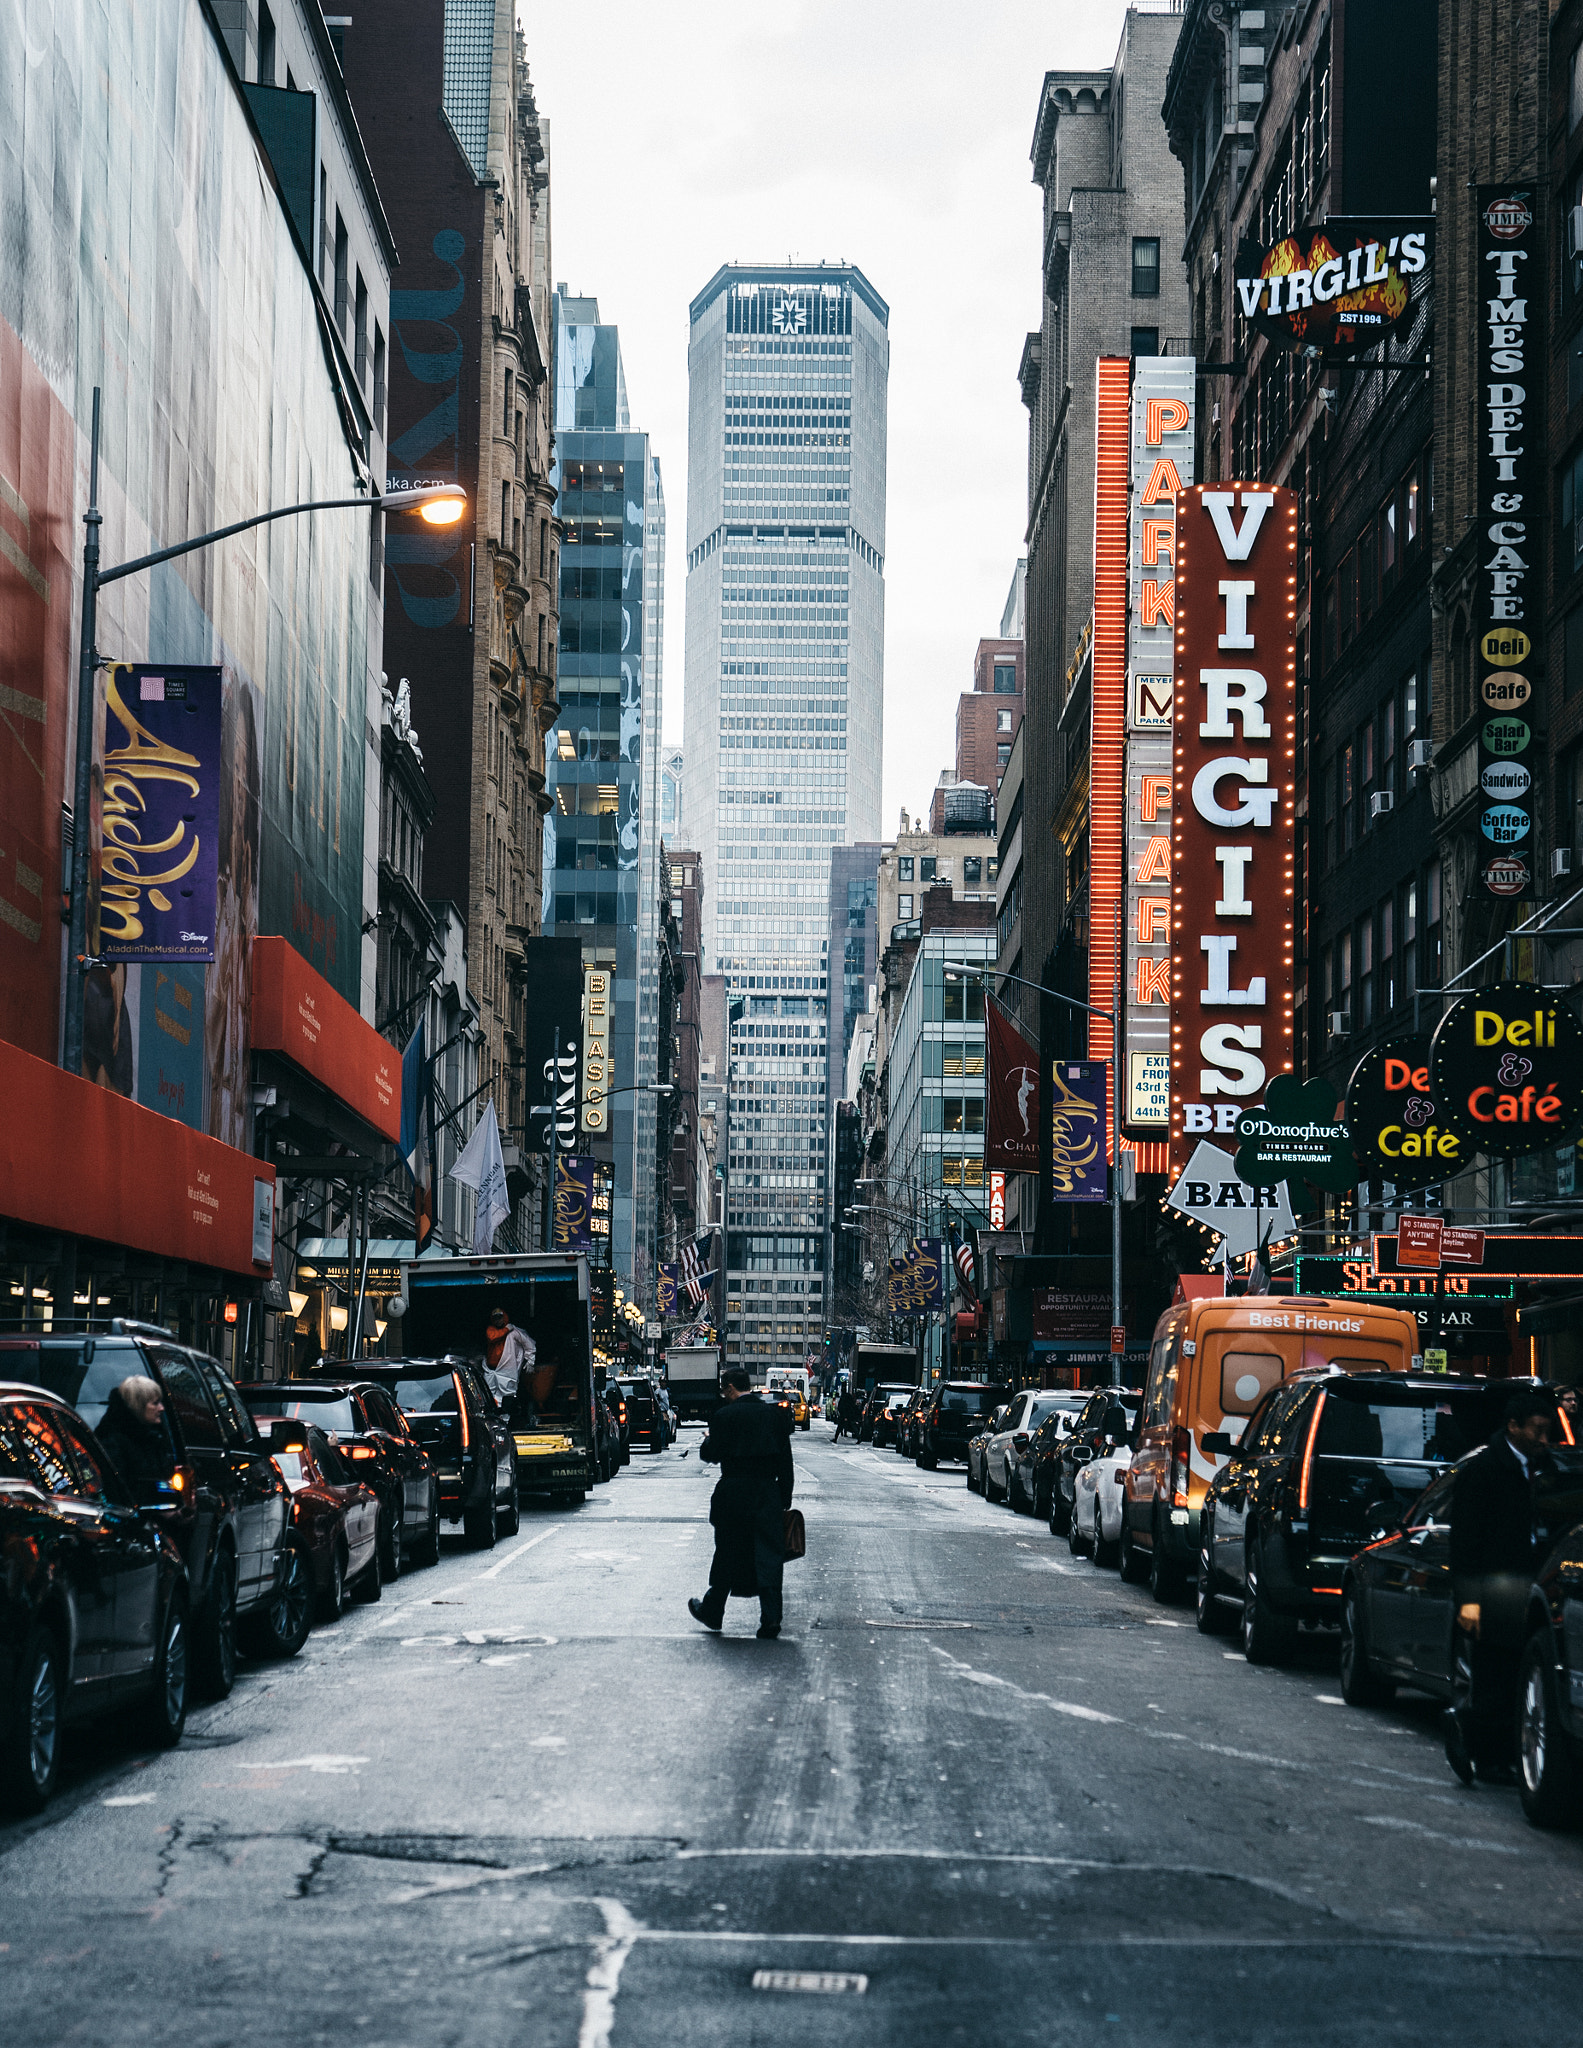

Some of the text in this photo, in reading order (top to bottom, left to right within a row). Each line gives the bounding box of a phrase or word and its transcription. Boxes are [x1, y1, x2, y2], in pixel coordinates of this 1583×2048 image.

[1482, 212, 1532, 226] TIMES
[1236, 233, 1426, 318] VIRGIL'S
[1484, 250, 1529, 620] TIMES DELI & CAFE
[1140, 398, 1190, 626] PARK
[1487, 638, 1524, 655] Deli
[1485, 682, 1526, 700] Cafe
[1486, 724, 1525, 738] Salad
[1494, 738, 1518, 752] Bar
[1482, 772, 1529, 788] Sandwich
[101, 663, 201, 941] Aladdin
[1191, 492, 1279, 1096] VIRGILS
[1482, 813, 1529, 827] Coffee
[1493, 827, 1518, 841] Bar
[1481, 870, 1531, 883] TIMES
[1136, 775, 1172, 1004] PARK
[179, 931, 208, 944] Disney
[106, 945, 209, 953] AladdinTheMusical.com
[1474, 1009, 1556, 1048] Deli
[586, 975, 606, 1127] BELASCO
[1384, 1059, 1430, 1091] De
[1498, 1053, 1532, 1087] &
[530, 1041, 577, 1149] aka.
[1136, 1082, 1160, 1092] 43rd
[1151, 1095, 1165, 1104] OR
[1468, 1082, 1562, 1123] Café
[1135, 1107, 1160, 1117] 44th
[1183, 1104, 1265, 1133] BB
[1404, 1097, 1435, 1127] &
[1053, 1061, 1099, 1192] Aladdin
[1240, 1119, 1349, 1141] O'Donoghue's
[1257, 1153, 1273, 1161] BAR
[1282, 1154, 1332, 1163] RESTAURANT
[556, 1154, 587, 1244] Aladdin
[1184, 1180, 1281, 1209] BAR
[1413, 1221, 1439, 1230] STANDING
[1407, 1230, 1435, 1239] ANYTIME
[1452, 1231, 1478, 1240] STANDING
[657, 1262, 675, 1312] Aladdin
[1047, 1294, 1114, 1303] RESTAURAN
[1249, 1312, 1290, 1328] Best
[1067, 1353, 1114, 1363] JIMMY'S
